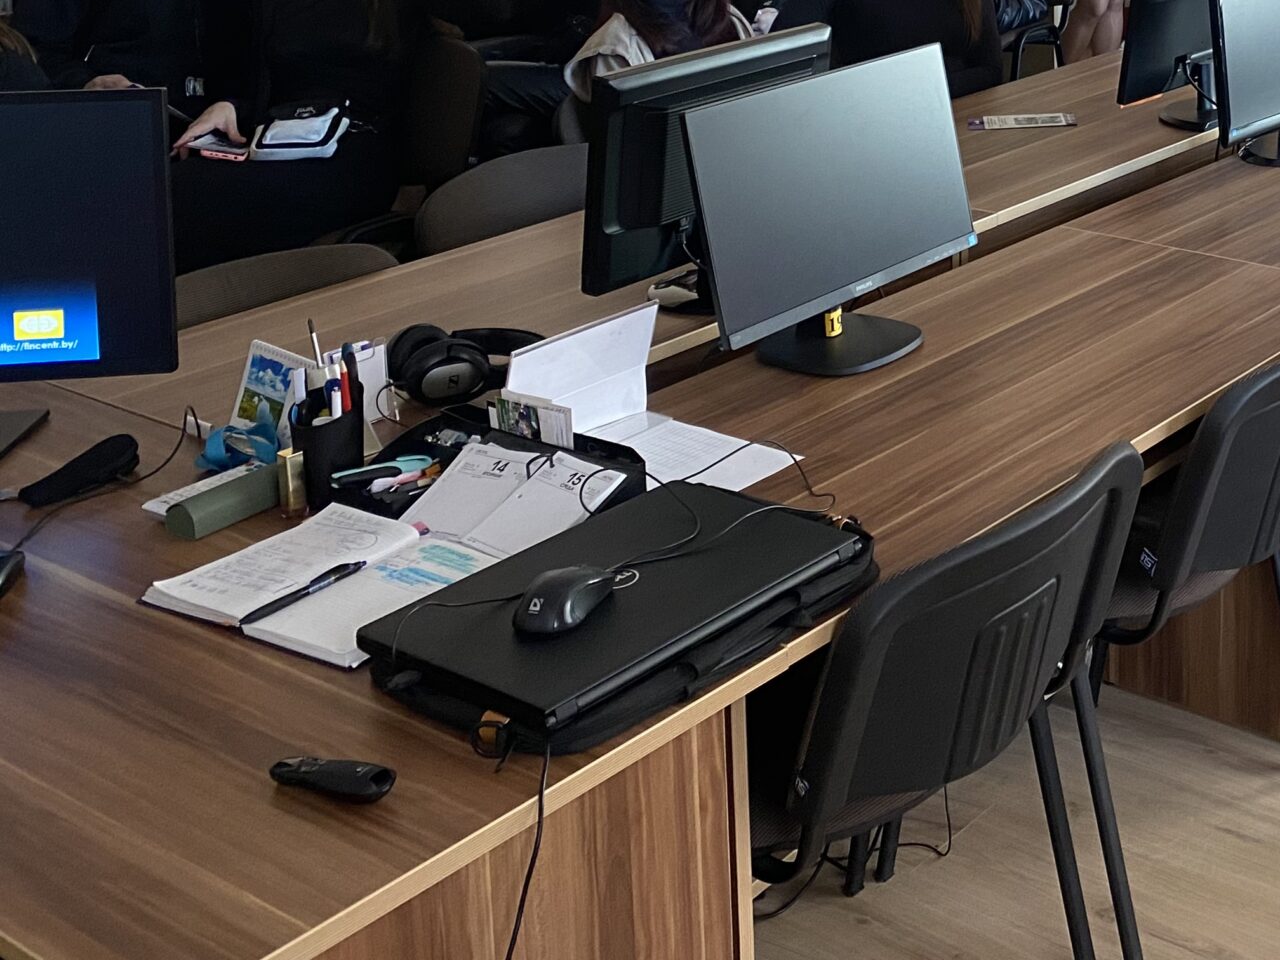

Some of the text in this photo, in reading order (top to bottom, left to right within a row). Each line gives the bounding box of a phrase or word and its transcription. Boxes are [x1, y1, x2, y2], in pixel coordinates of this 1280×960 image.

[0, 339, 78, 352] ttp://fincentr.by/
[490, 460, 510, 473] 14
[566, 472, 586, 486] 15
